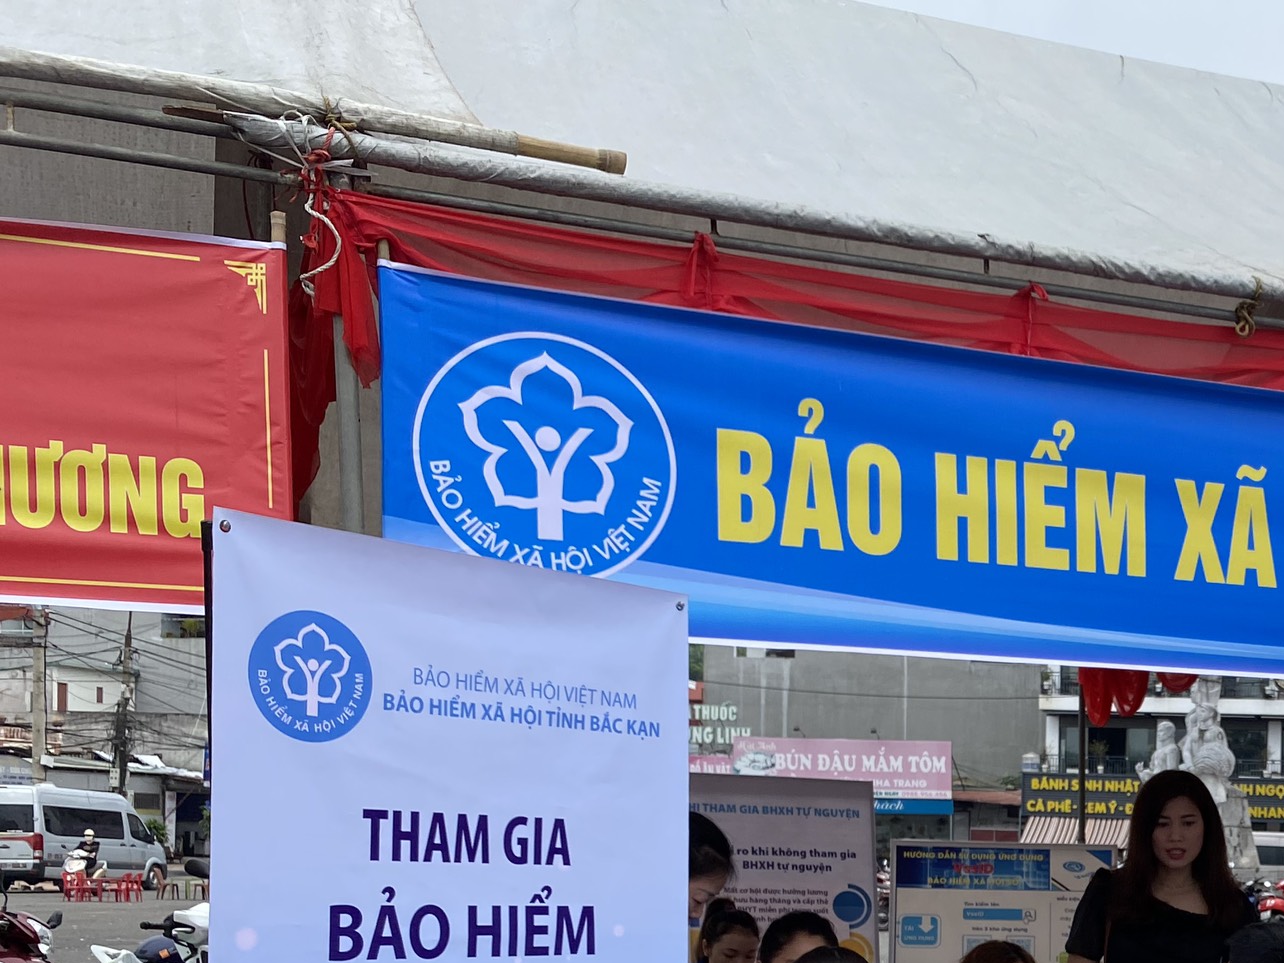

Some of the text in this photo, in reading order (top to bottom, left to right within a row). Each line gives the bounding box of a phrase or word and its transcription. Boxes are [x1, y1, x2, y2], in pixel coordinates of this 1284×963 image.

[0, 440, 204, 538] ƯƠNG
[717, 398, 901, 555] BẢO
[935, 420, 1146, 576] HIỂM
[1174, 464, 1277, 588] XÃ
[430, 460, 662, 574] BẢO HIỂM XÃ HỘI VIỆT NAM
[258, 669, 363, 733] BẢO HIỂM XÃ HỘI VIỆT NAM
[413, 664, 637, 710] BẢO HIỂM XÃ HỘI VIỆT NAM
[383, 690, 660, 740] BẢO HIỂM XÃ HỘI TỈNH BẮC KẠN
[693, 701, 737, 721] THUỐC
[775, 746, 947, 776] BÚN ĐẬU MẮM TÔM
[873, 800, 904, 811] hách
[1026, 798, 1045, 812] CÀ
[1030, 776, 1141, 797] BÁNH SNH NHẬT
[702, 802, 737, 814] THAM
[739, 804, 760, 815] GIA
[762, 805, 794, 816] BHXH
[795, 806, 813, 819] TỰ
[814, 807, 861, 820] NGUYỆN
[362, 808, 571, 866] THAM GIA
[751, 846, 769, 856] khi
[771, 847, 807, 859] không
[809, 848, 837, 858] tham
[840, 850, 857, 861] gia
[742, 861, 832, 875] BHXH tự nguyện
[328, 885, 596, 962] BẢO HIỂM
